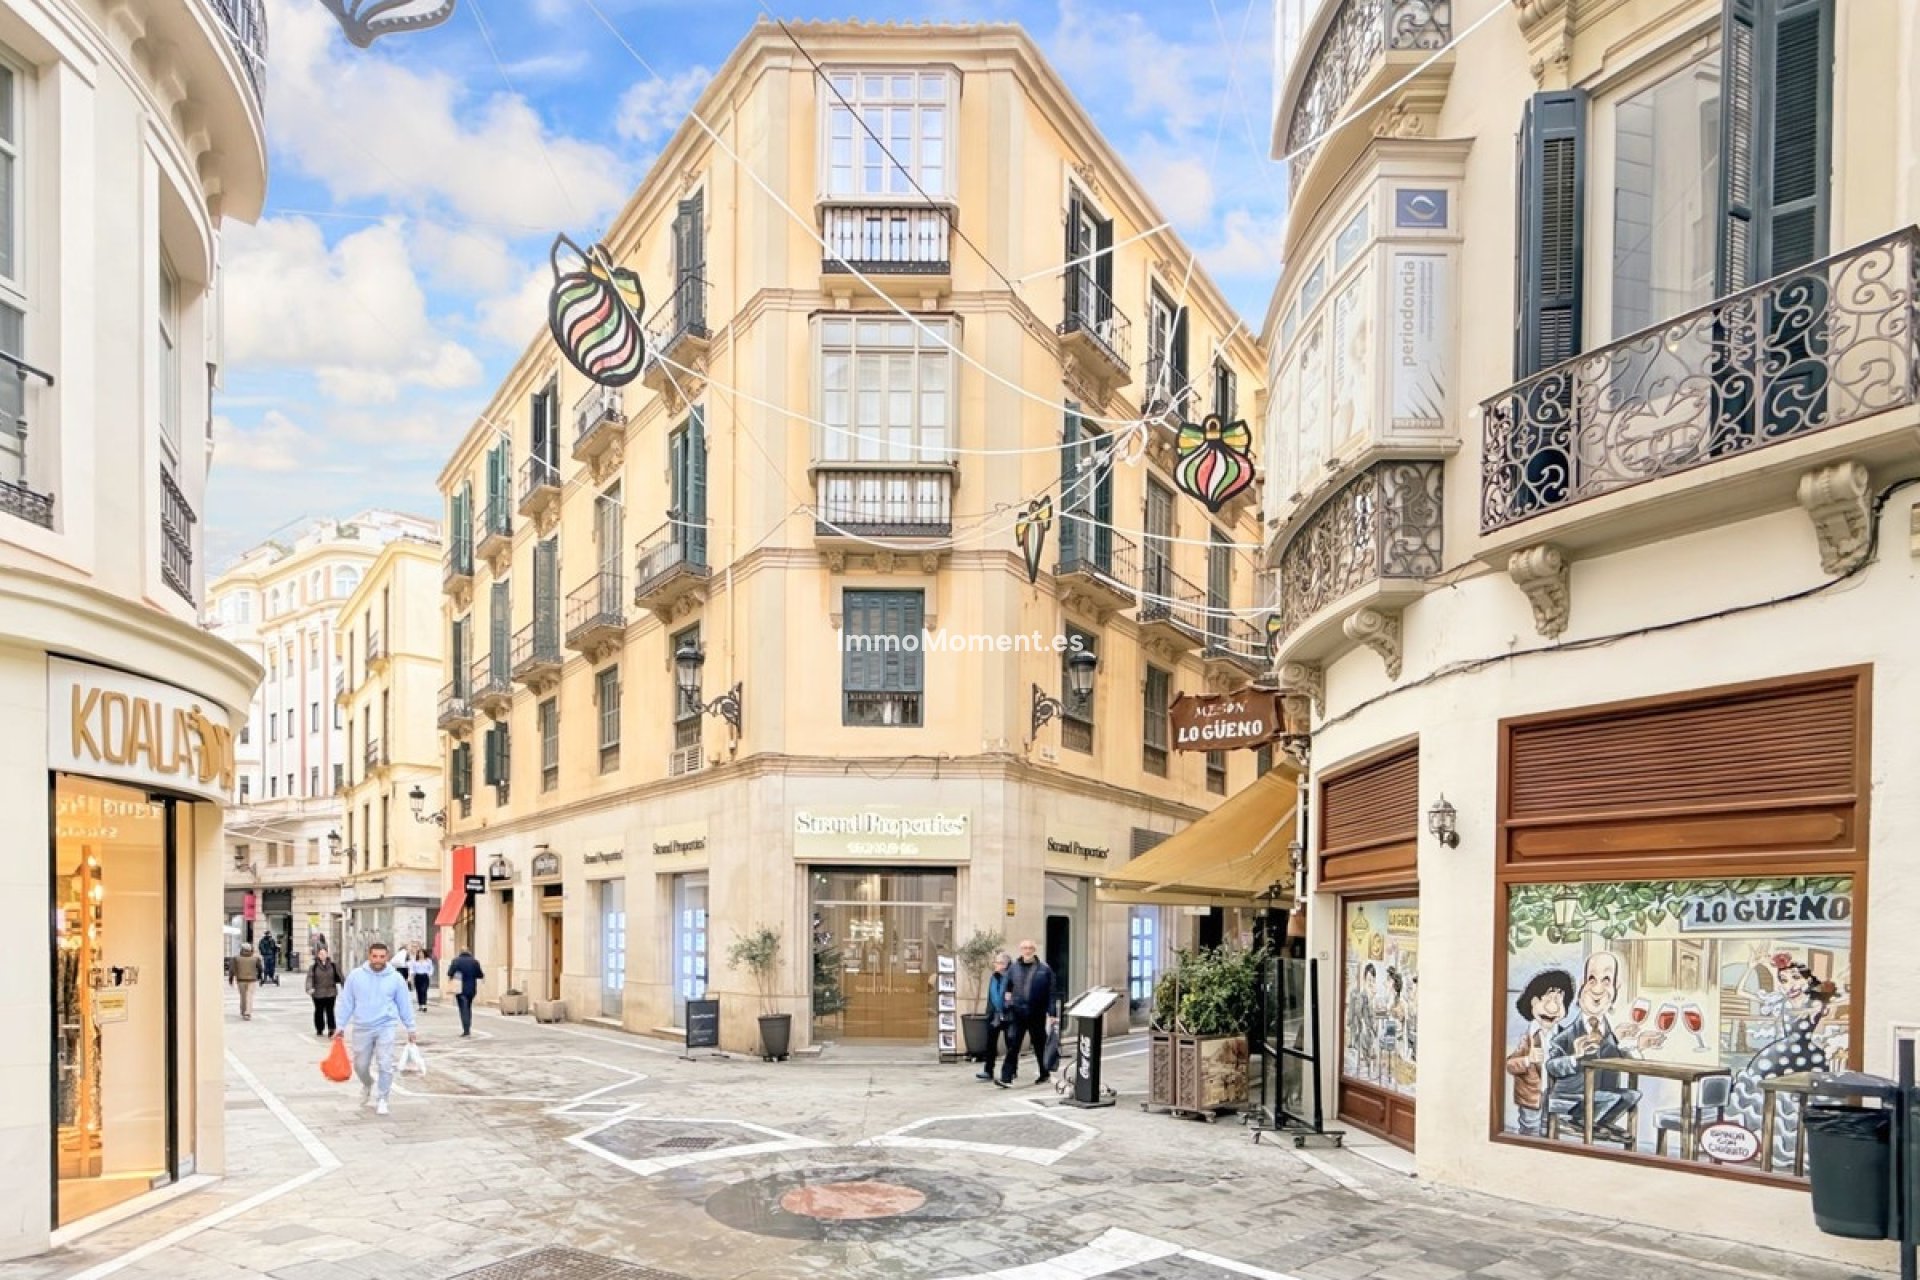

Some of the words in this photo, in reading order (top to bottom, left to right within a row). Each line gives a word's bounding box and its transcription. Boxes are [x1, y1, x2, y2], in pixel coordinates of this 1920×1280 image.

[1399, 260, 1417, 367] periodoncia
[1178, 726, 1200, 742] LO
[1202, 719, 1262, 740] GÜENO
[796, 811, 861, 835] Strand
[1047, 837, 1072, 853] Strand
[1696, 900, 1727, 923] LO
[1734, 893, 1850, 923] GÜENO
